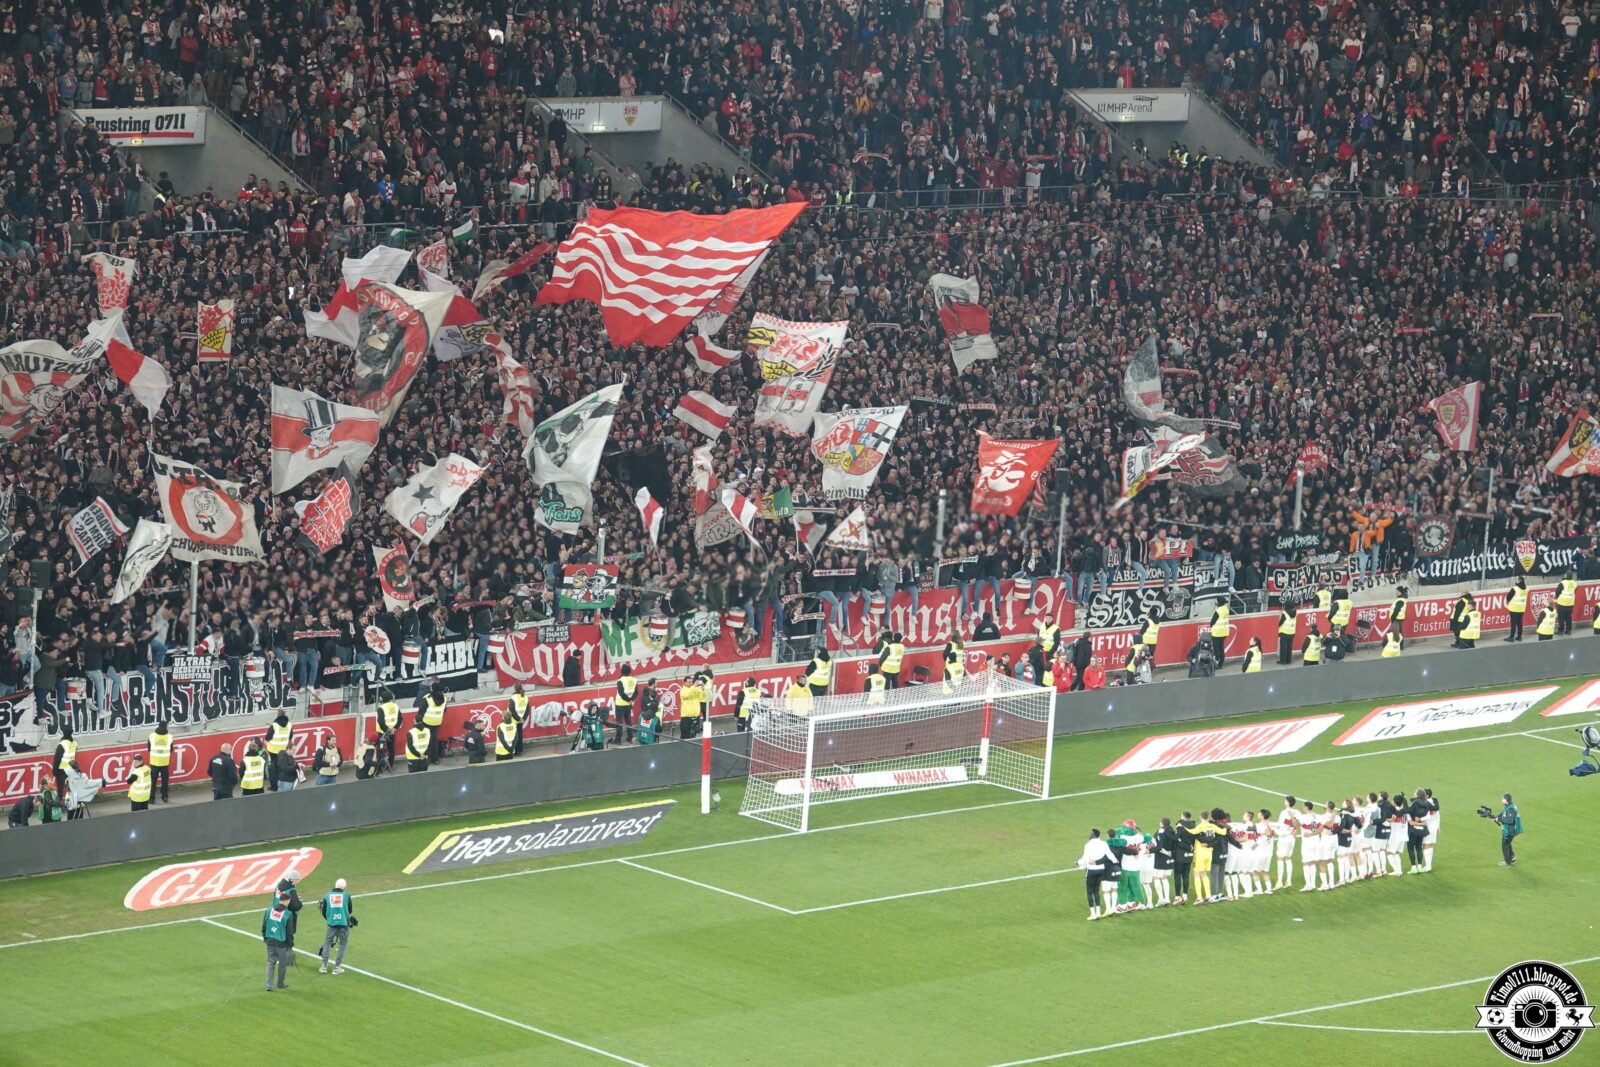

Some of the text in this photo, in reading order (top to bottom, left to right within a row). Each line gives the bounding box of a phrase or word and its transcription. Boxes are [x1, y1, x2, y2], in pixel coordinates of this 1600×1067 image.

[1128, 101, 1154, 113] Arena
[154, 112, 187, 131] 0711
[1274, 565, 1320, 589] CREW
[1305, 612, 1317, 626] 36
[173, 656, 212, 666] ULTRAS
[856, 660, 870, 675] 35
[892, 768, 949, 785] WINAMAX
[506, 811, 662, 854] solarinvest
[441, 835, 513, 864] hep
[150, 849, 311, 907] GAZI
[332, 913, 342, 921] 20
